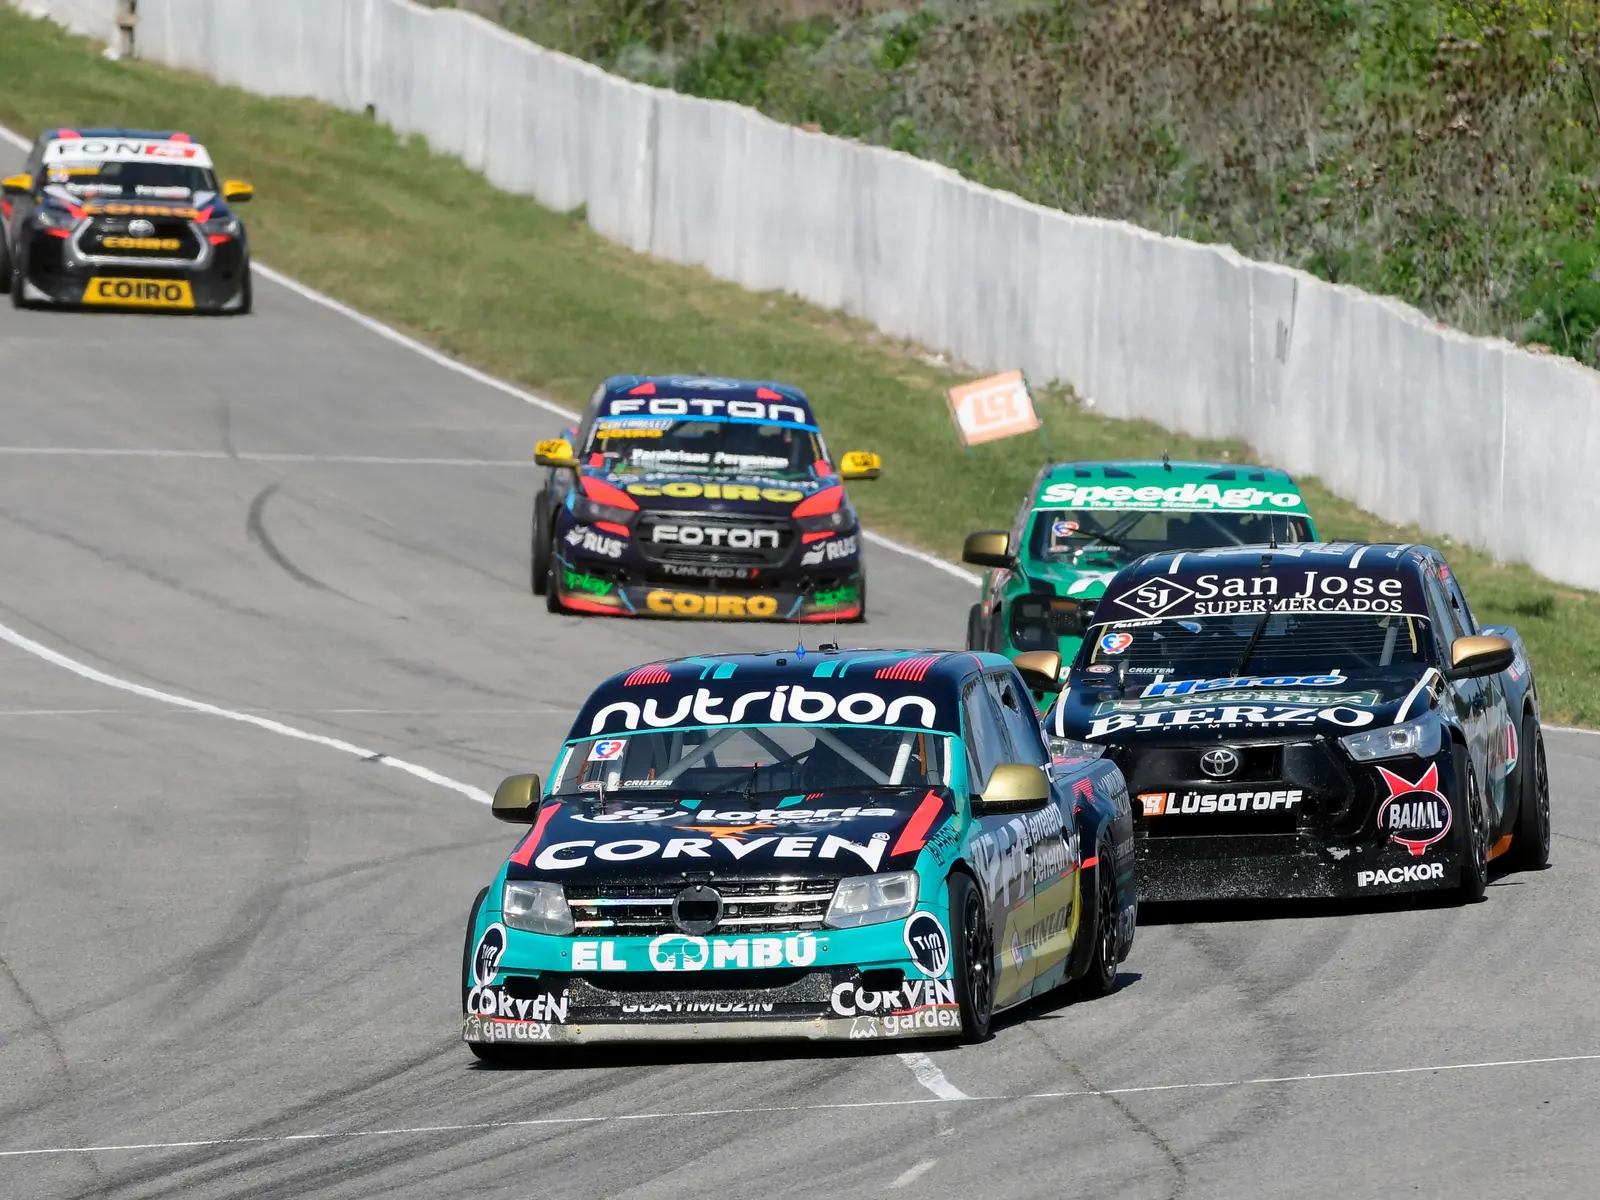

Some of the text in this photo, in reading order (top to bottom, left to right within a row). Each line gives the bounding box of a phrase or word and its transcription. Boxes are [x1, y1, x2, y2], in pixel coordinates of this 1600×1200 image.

[98, 281, 183, 302] COIRO
[610, 398, 805, 423] FOTON
[627, 482, 804, 503] COIRO
[1042, 483, 1301, 508] SpeedAgro
[582, 532, 622, 558] RUS
[652, 525, 779, 548] FOTON
[1194, 571, 1403, 600] San Jose
[647, 591, 778, 616] COIRO
[1193, 598, 1403, 616] SUPERMERCADOS
[590, 684, 937, 736] nutribon
[1085, 705, 1375, 740] BIERZO
[1163, 721, 1286, 731] FIAMBRES
[535, 833, 890, 873] CORVEN
[1357, 862, 1445, 887] PACKOR
[572, 941, 627, 971] EL
[467, 985, 568, 1023] CORVEN
[831, 979, 956, 1016] CORVEN
[483, 1021, 552, 1043] gardex
[883, 1006, 961, 1037] gardex
